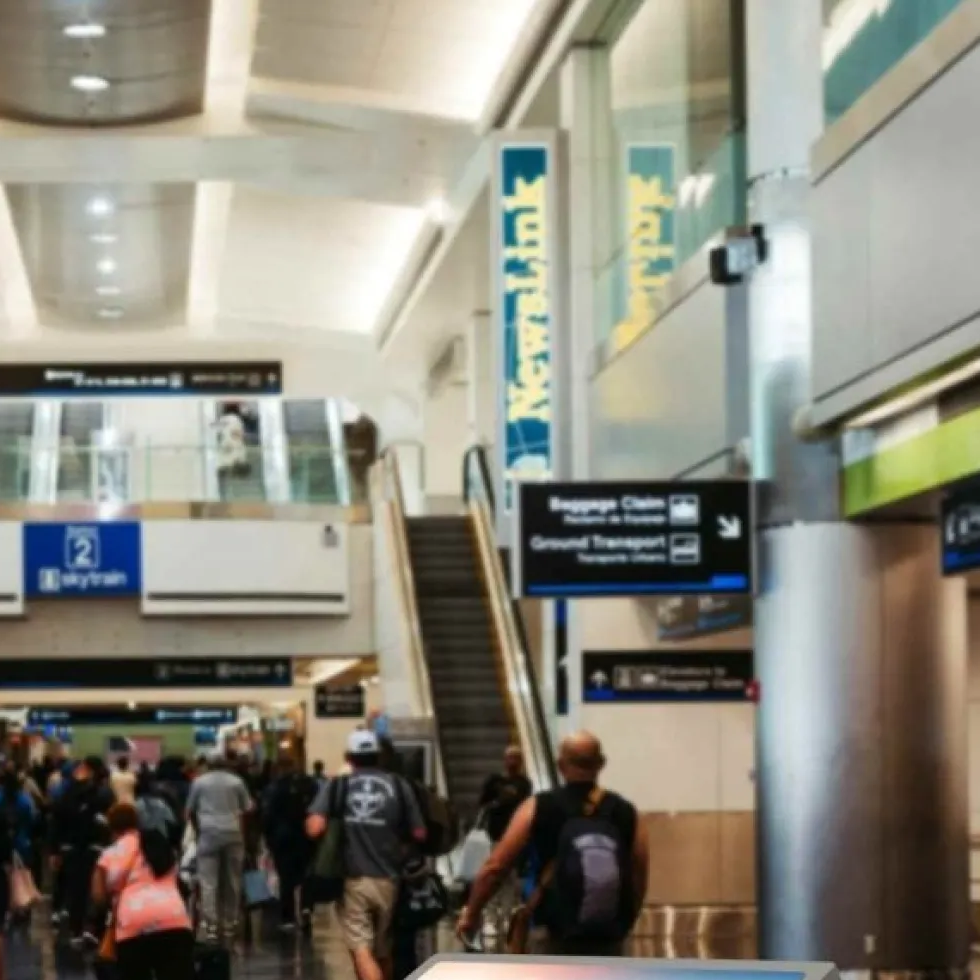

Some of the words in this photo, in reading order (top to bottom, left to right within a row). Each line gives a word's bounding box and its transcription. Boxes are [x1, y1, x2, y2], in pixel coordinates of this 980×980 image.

[503, 176, 549, 422] NewsLink
[73, 538, 92, 565] 2
[530, 536, 588, 550] Ground
[592, 535, 666, 552] Transport
